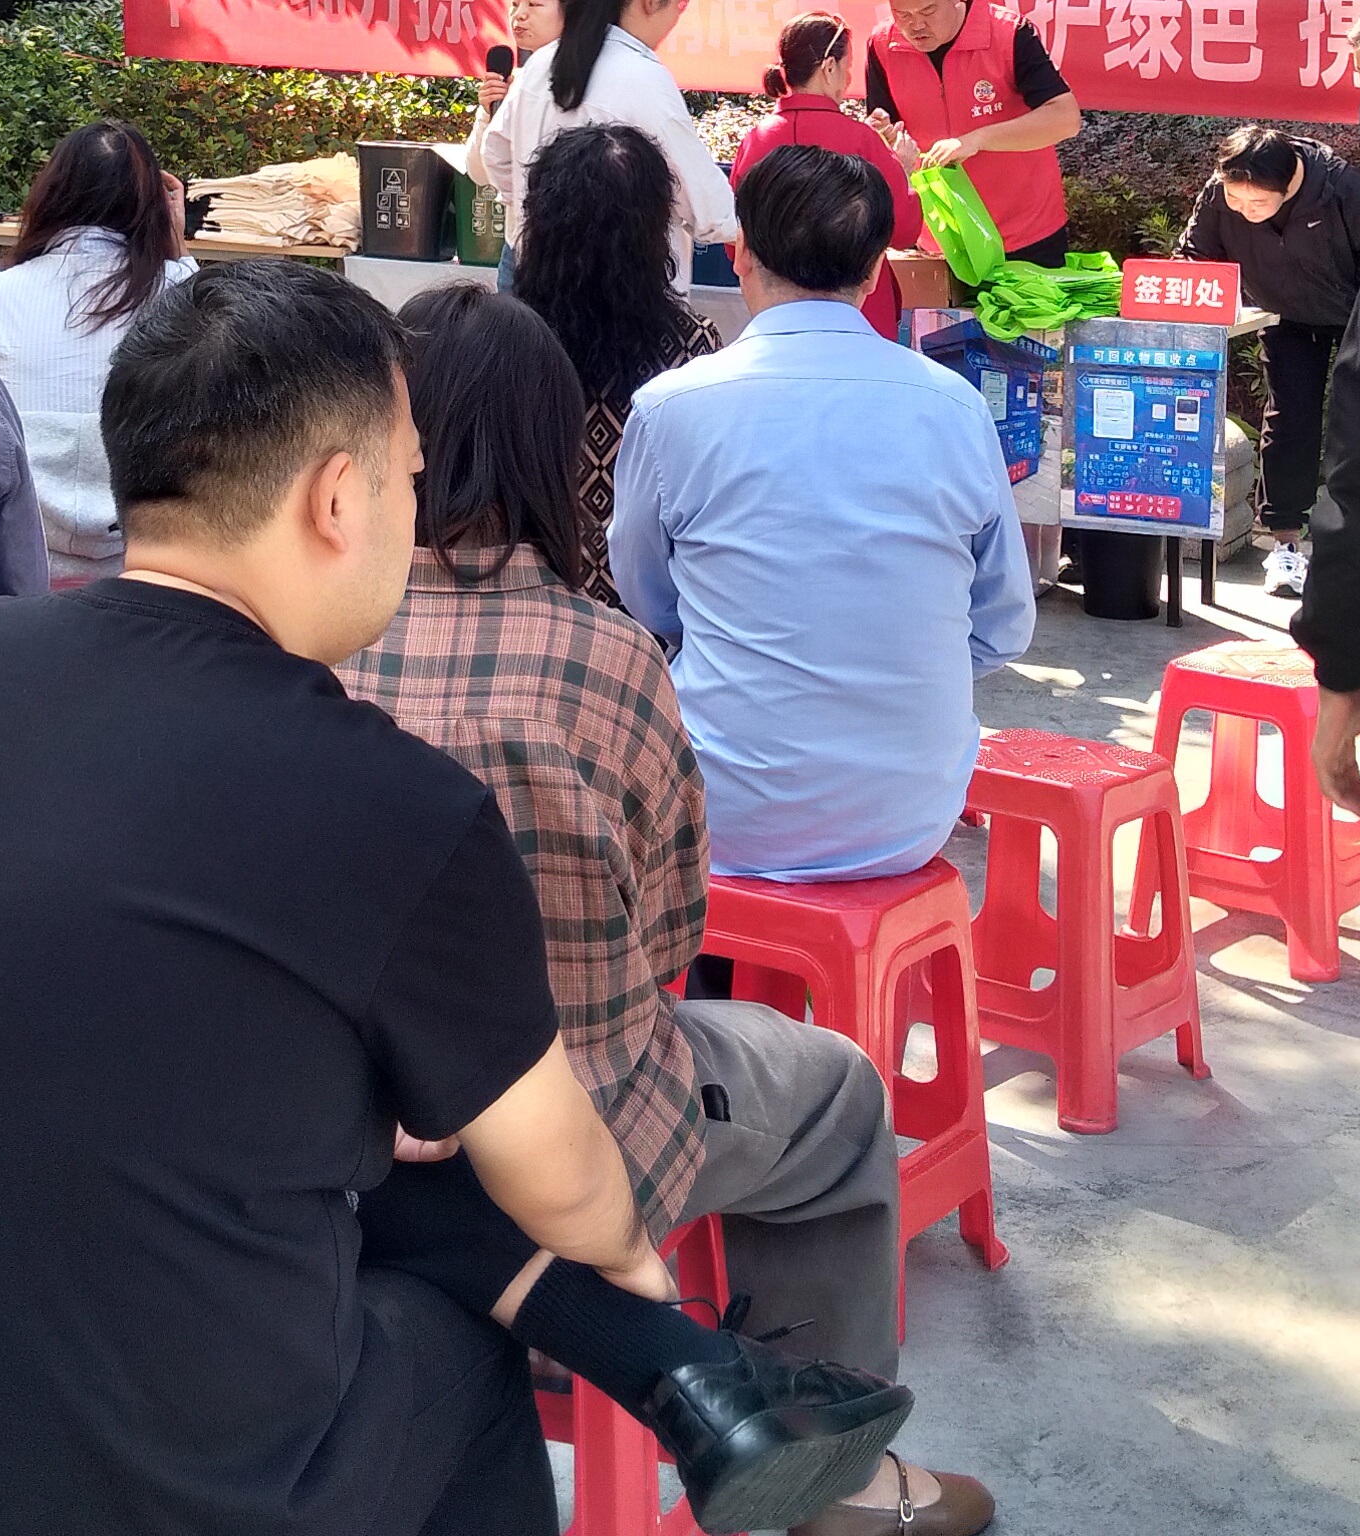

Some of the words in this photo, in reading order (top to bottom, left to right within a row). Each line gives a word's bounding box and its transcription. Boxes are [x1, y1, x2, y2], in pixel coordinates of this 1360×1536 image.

[1134, 274, 1224, 308] 签到处
[1093, 349, 1198, 366] 可回收物回收点
